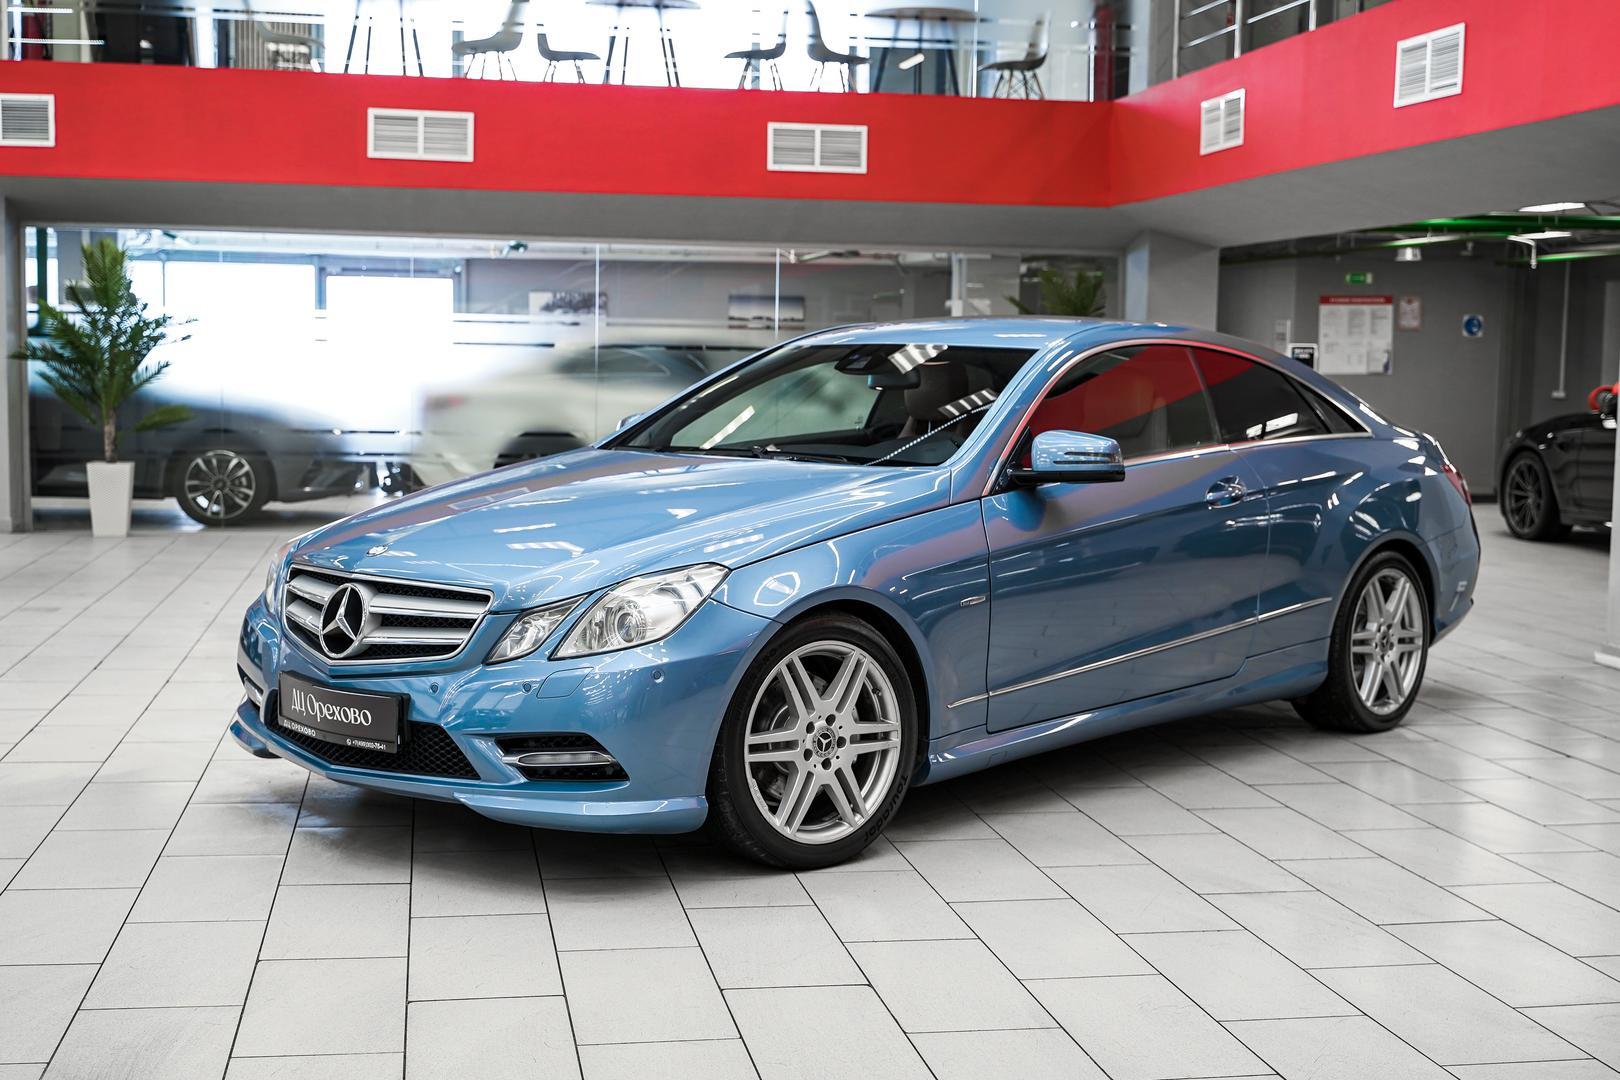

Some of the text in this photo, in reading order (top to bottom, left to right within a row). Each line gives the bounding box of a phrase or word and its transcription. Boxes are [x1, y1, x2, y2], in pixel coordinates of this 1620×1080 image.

[291, 688, 372, 726] ДЦ Орехово
[292, 722, 316, 737] ОРЕХОВО
[863, 775, 909, 843] Tourador
